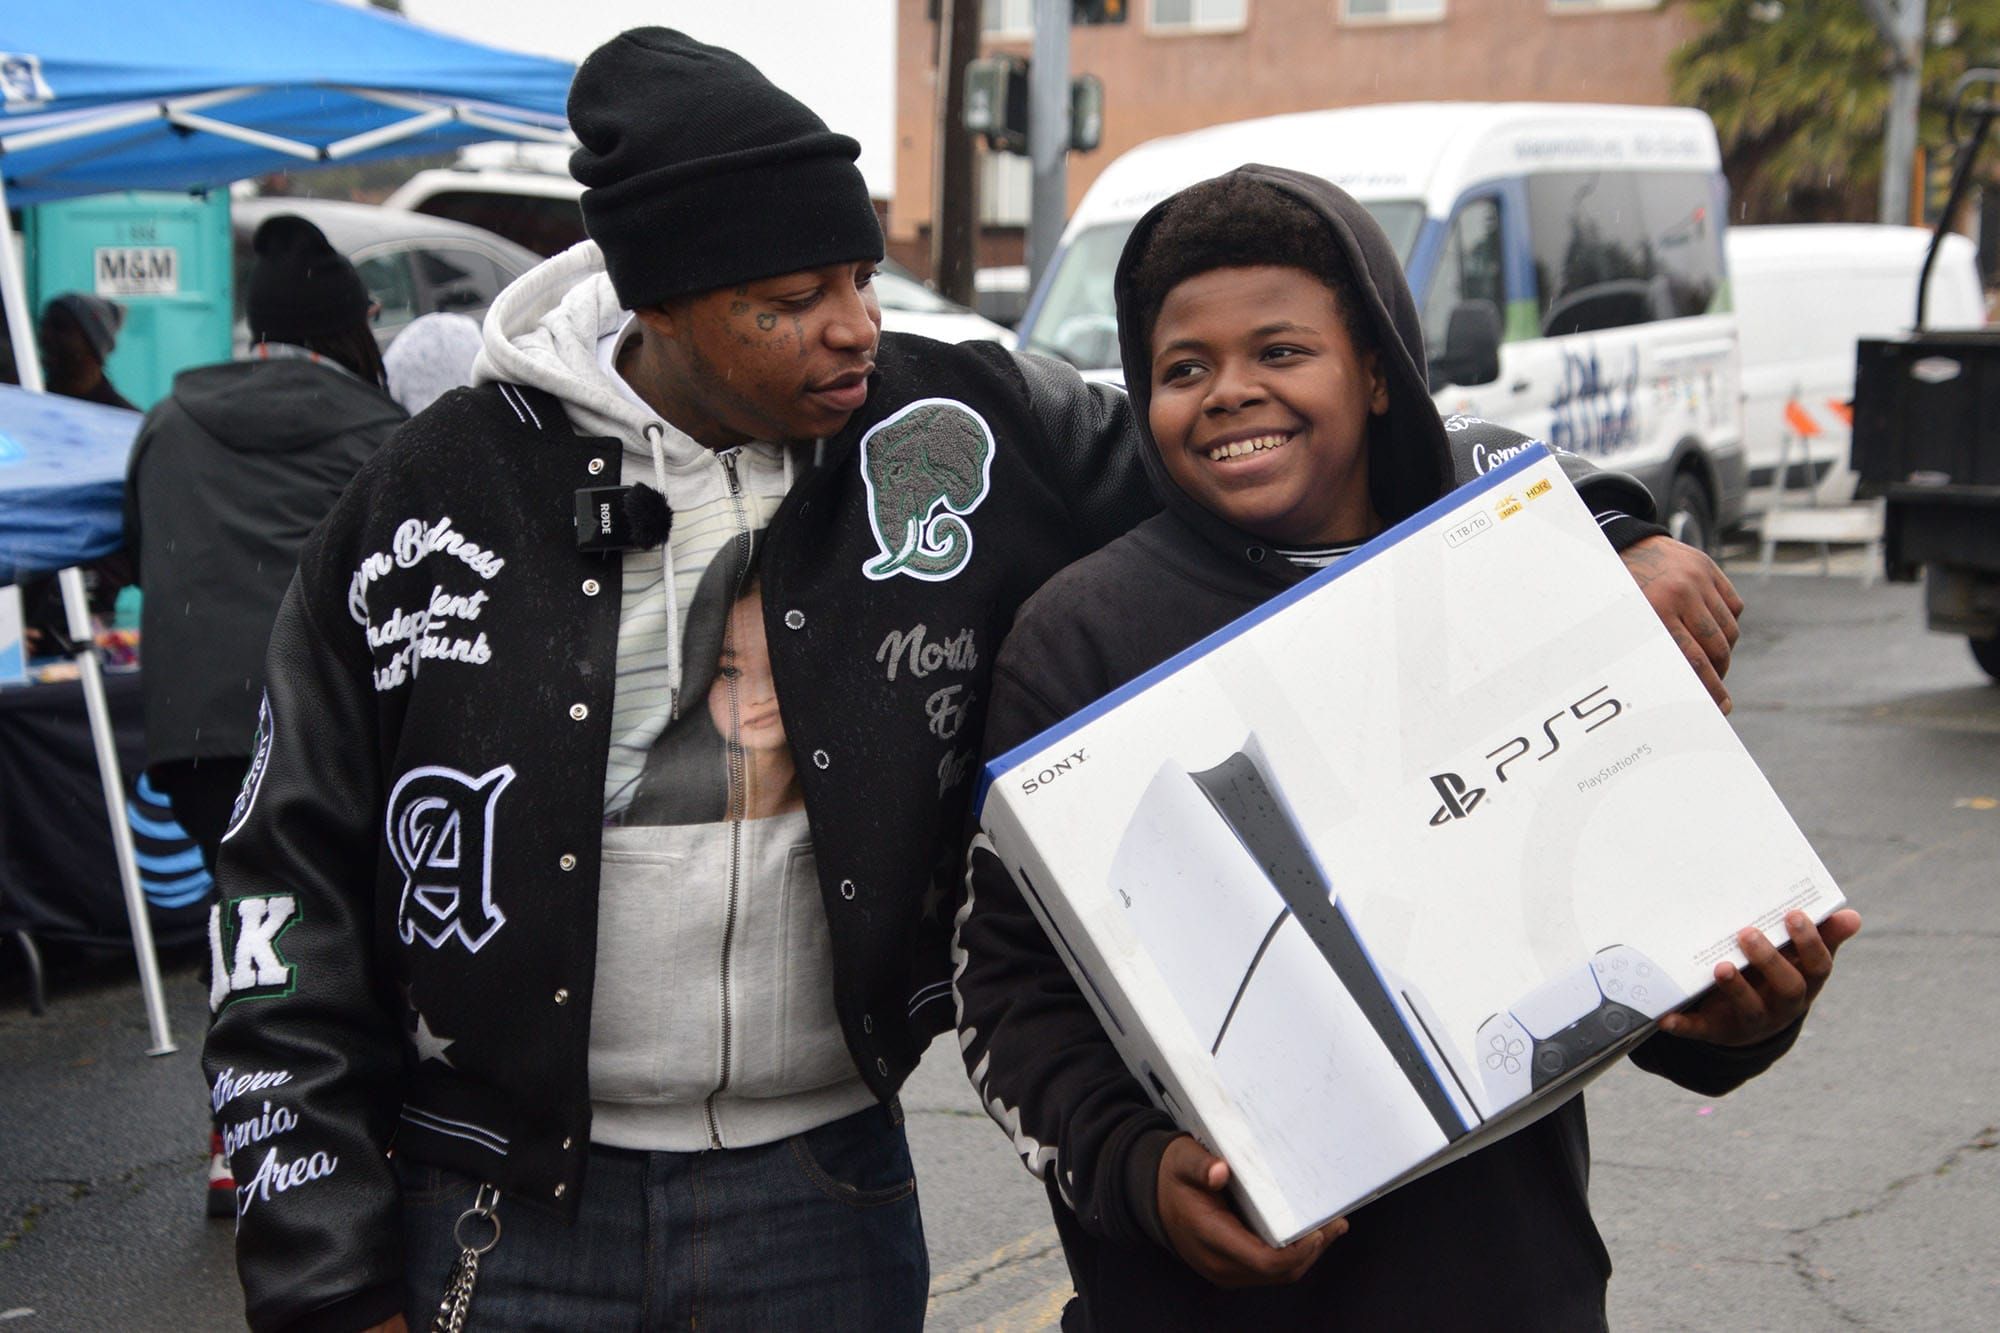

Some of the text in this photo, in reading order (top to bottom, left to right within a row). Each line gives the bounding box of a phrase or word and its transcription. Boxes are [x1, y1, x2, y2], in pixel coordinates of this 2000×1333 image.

[101, 254, 171, 280] M&M
[1525, 481, 1549, 499] HDR
[876, 623, 978, 681] North
[1485, 685, 1622, 784] PS5
[1022, 747, 1086, 796] SONY
[241, 1146, 338, 1217] Area
